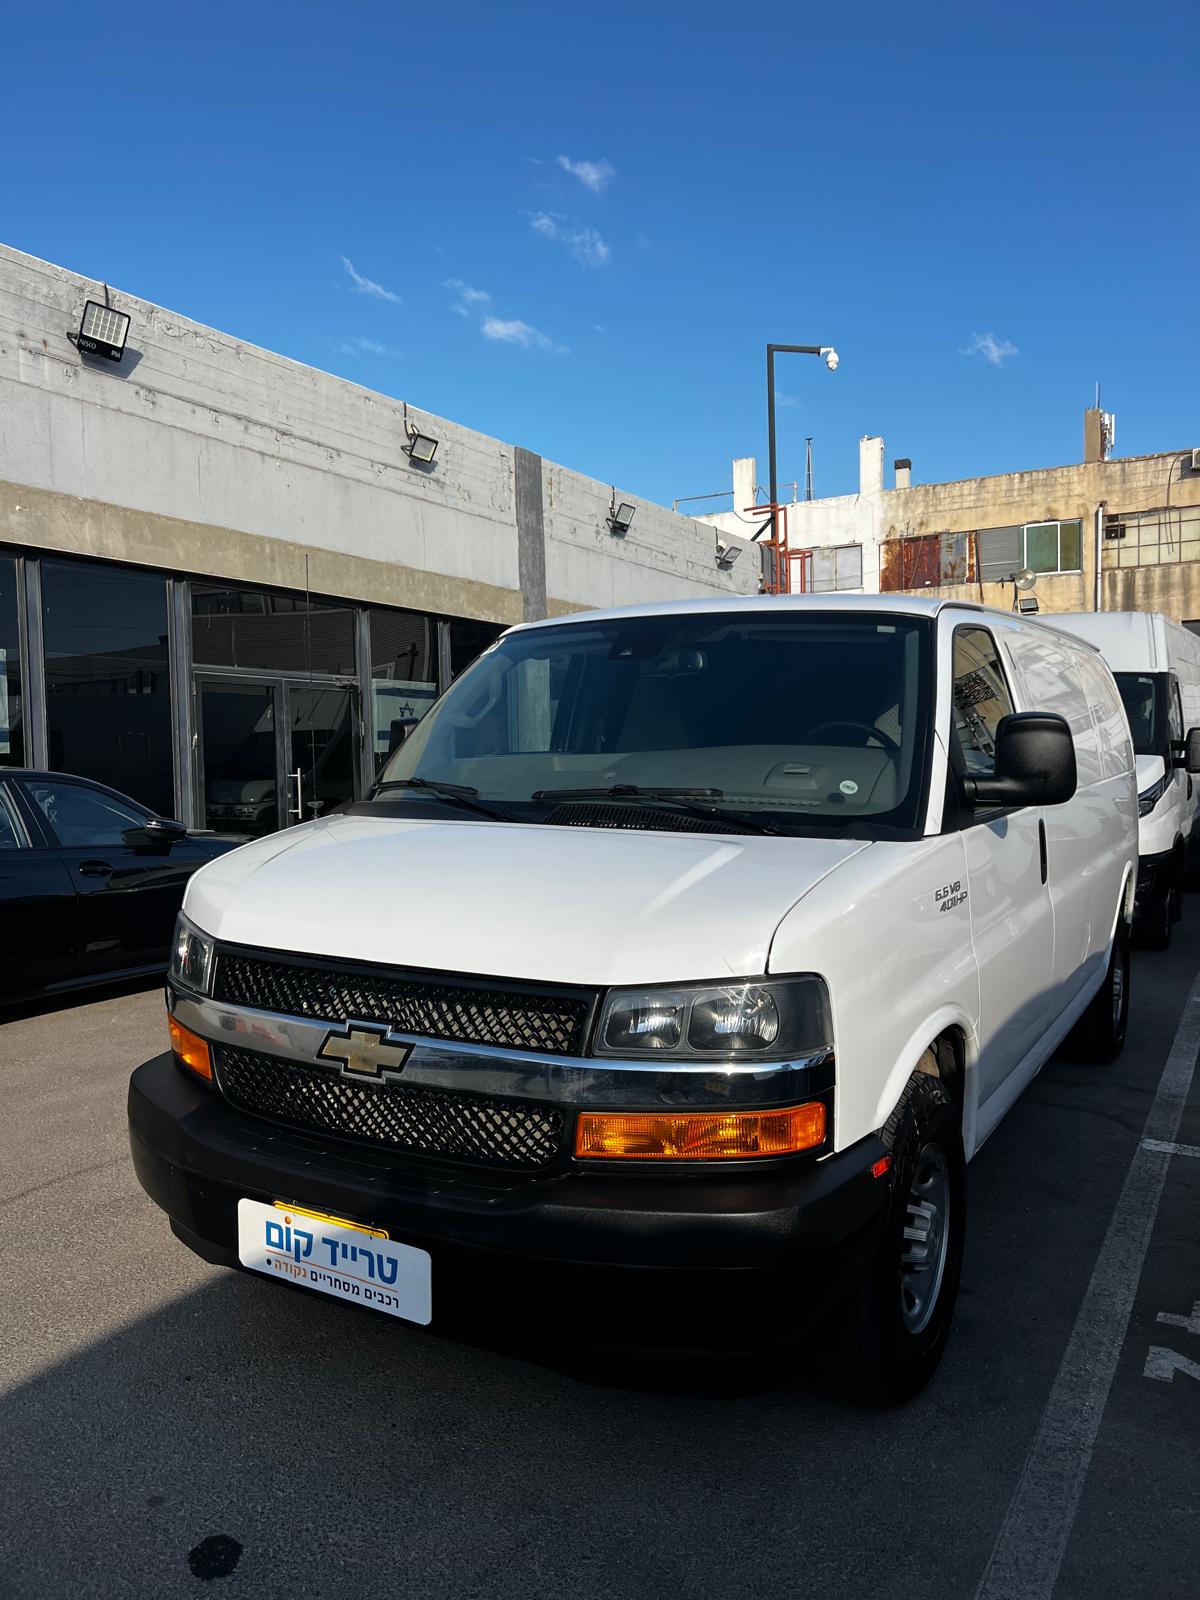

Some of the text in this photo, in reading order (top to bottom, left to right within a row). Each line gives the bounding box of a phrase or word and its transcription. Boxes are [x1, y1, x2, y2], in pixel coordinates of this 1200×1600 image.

[949, 881, 961, 894] V8
[265, 1217, 398, 1285] טרייד קום
[310, 1270, 360, 1296] מסחריים
[364, 1288, 399, 1309] רכבים
